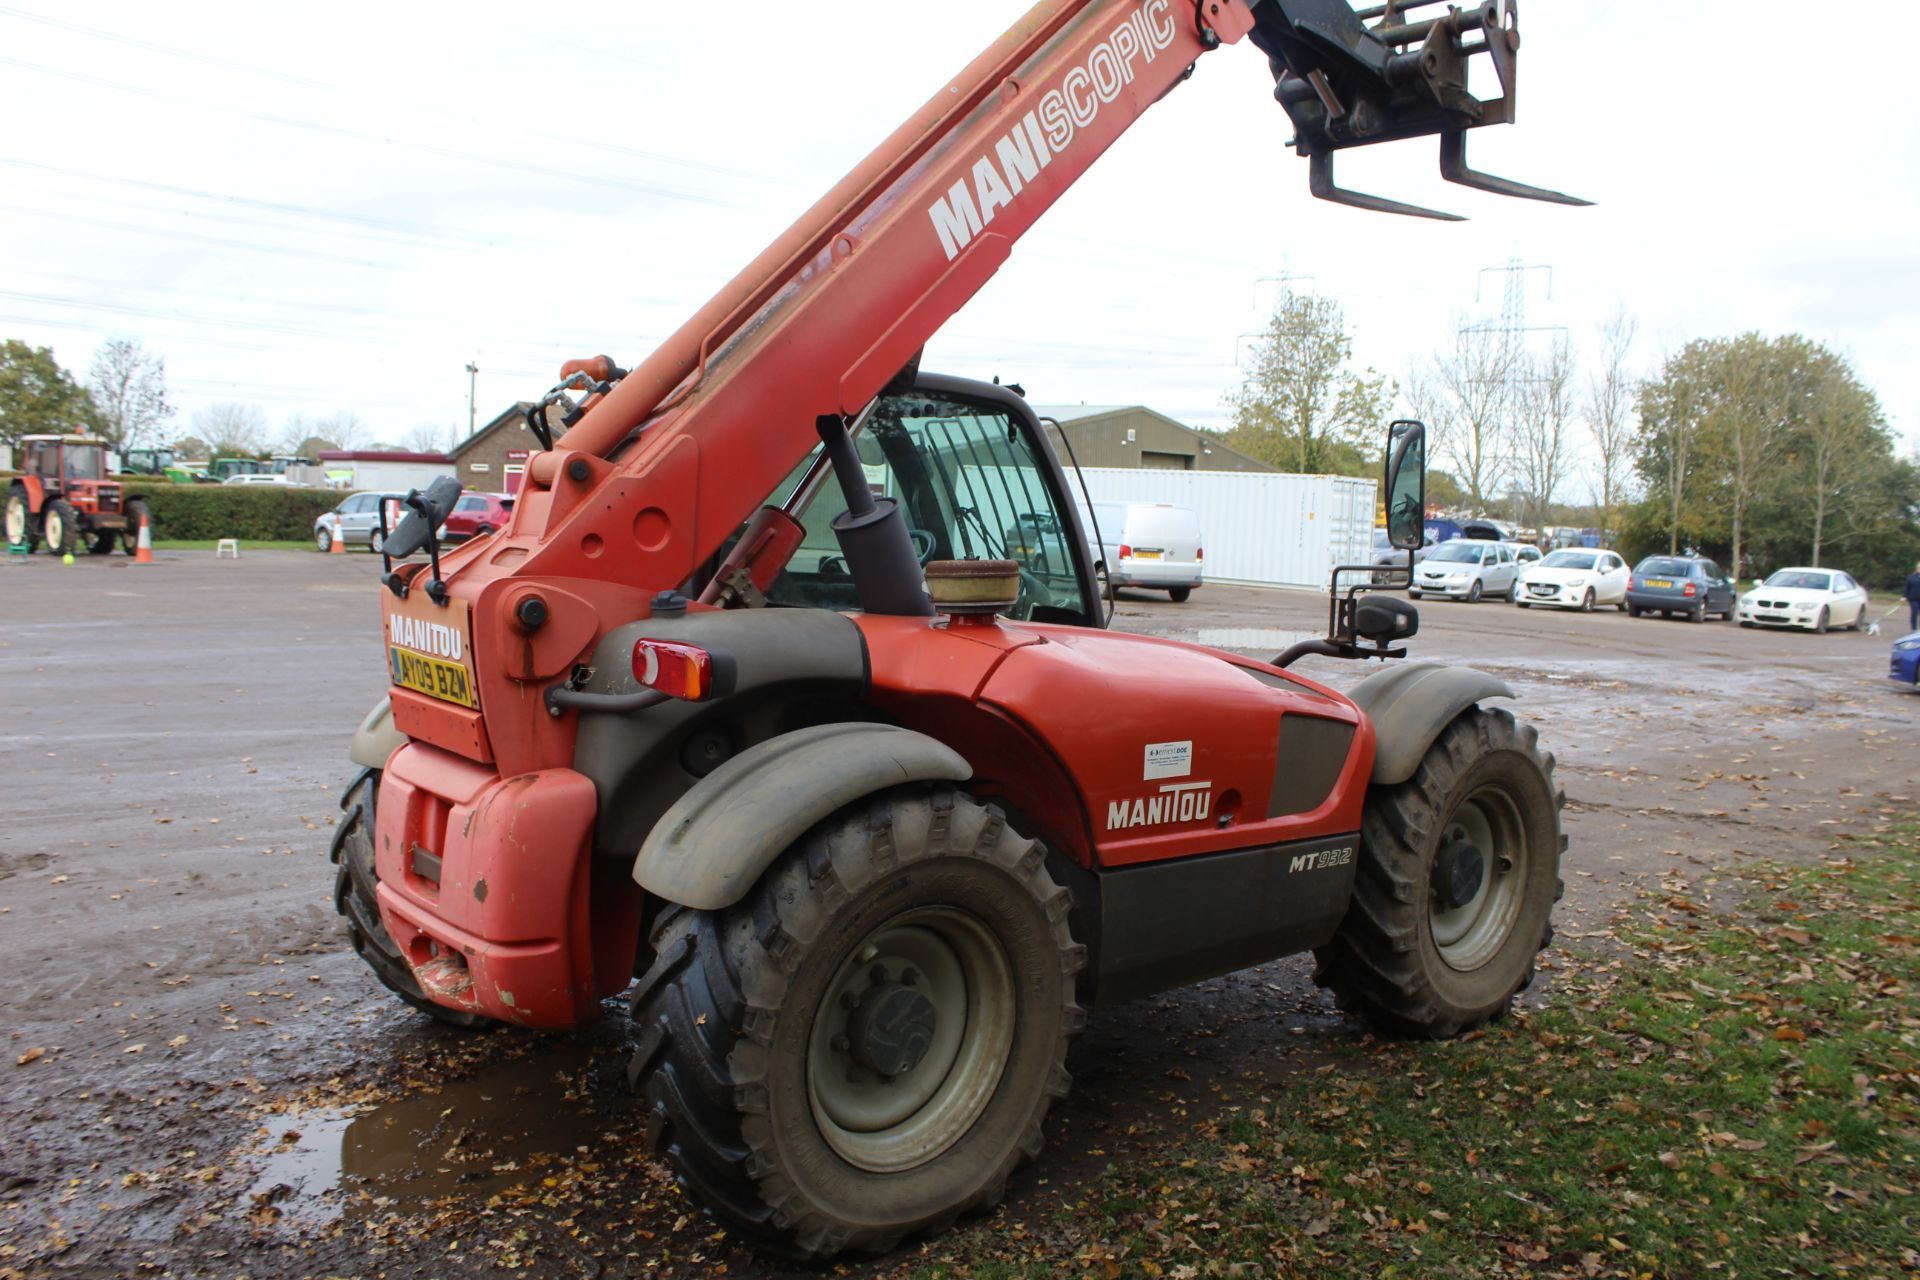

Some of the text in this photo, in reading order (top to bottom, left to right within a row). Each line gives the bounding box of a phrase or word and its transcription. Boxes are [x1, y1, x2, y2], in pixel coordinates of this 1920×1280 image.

[928, 0, 1176, 262] MANISCOPIC
[390, 614, 461, 660] MANITOU
[401, 653, 468, 702] AY09 BZM
[1107, 781, 1212, 830] MANITOU
[1289, 847, 1352, 873] MT932
